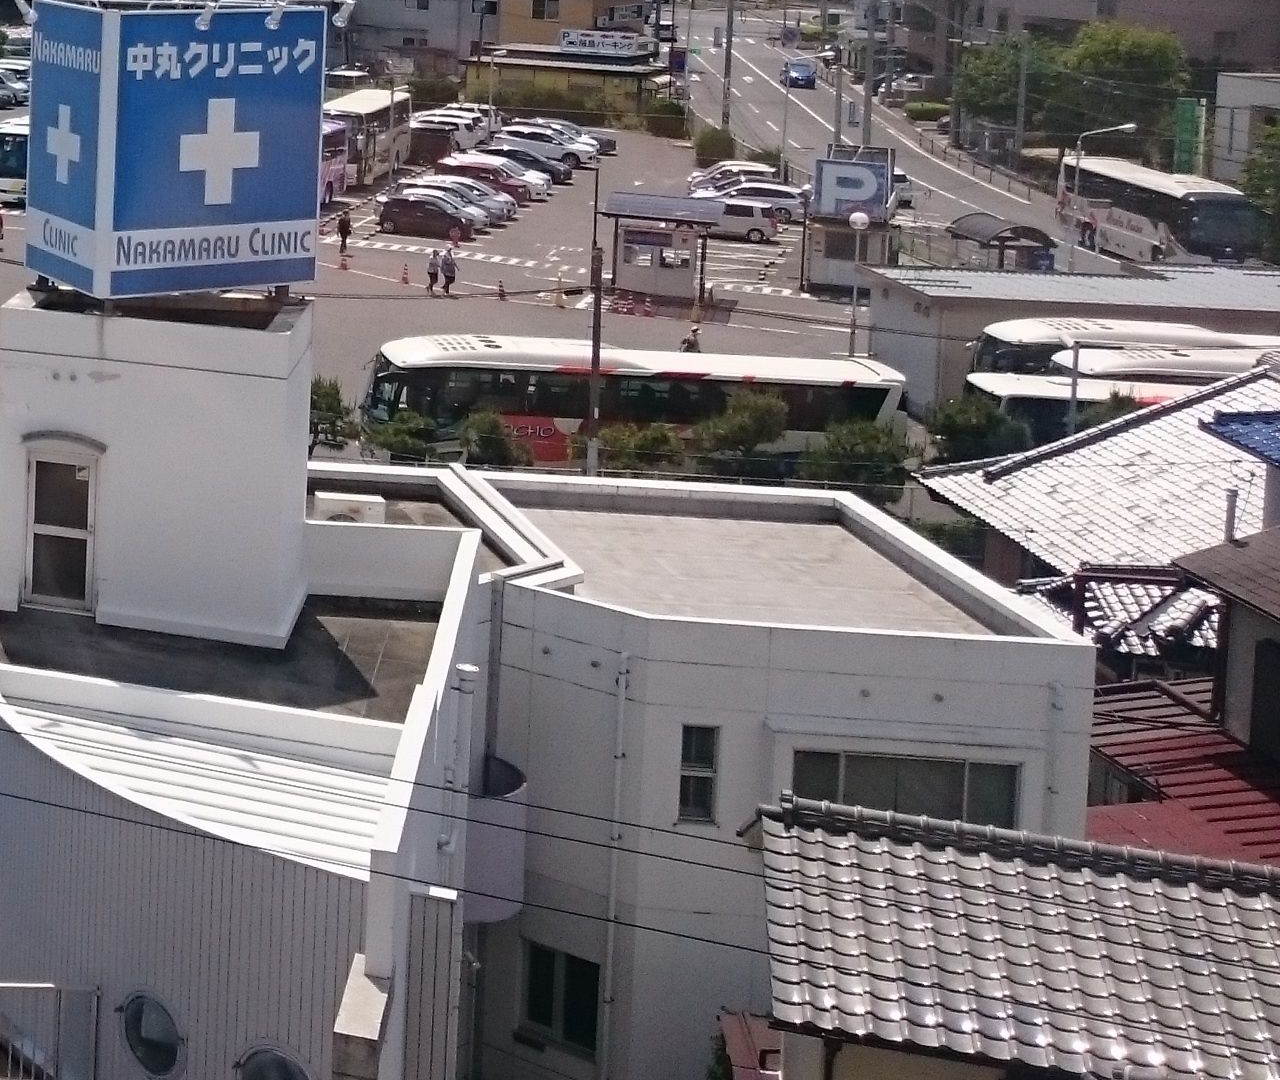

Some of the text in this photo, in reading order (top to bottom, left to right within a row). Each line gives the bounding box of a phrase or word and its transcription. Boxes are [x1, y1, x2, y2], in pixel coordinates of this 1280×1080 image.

[34, 30, 101, 74] NAKAMARU
[562, 31, 570, 41] P
[126, 37, 317, 81] 中丸クリニック
[820, 162, 878, 215] P
[42, 217, 79, 258] CLINIC
[116, 227, 311, 267] NAKAMARU CLINIC
